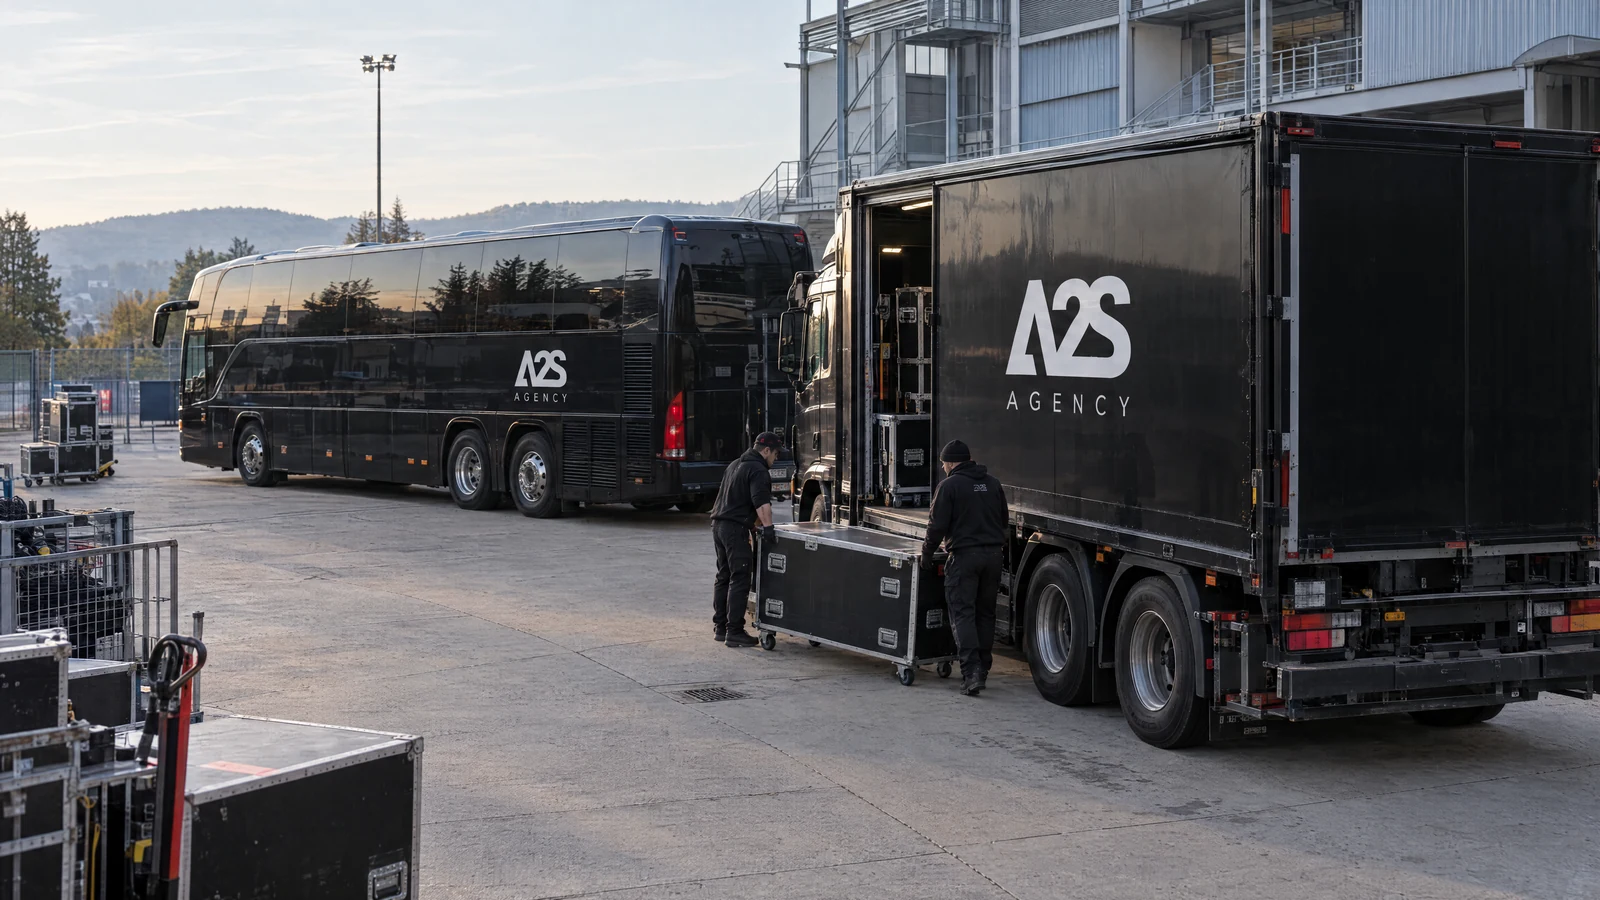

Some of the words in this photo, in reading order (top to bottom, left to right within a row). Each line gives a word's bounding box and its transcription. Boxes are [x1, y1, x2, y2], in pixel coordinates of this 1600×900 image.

[1005, 275, 1131, 379] A2S
[514, 349, 567, 388] A2S
[513, 392, 568, 403] AGENCY
[1006, 390, 1130, 417] AGENCY
